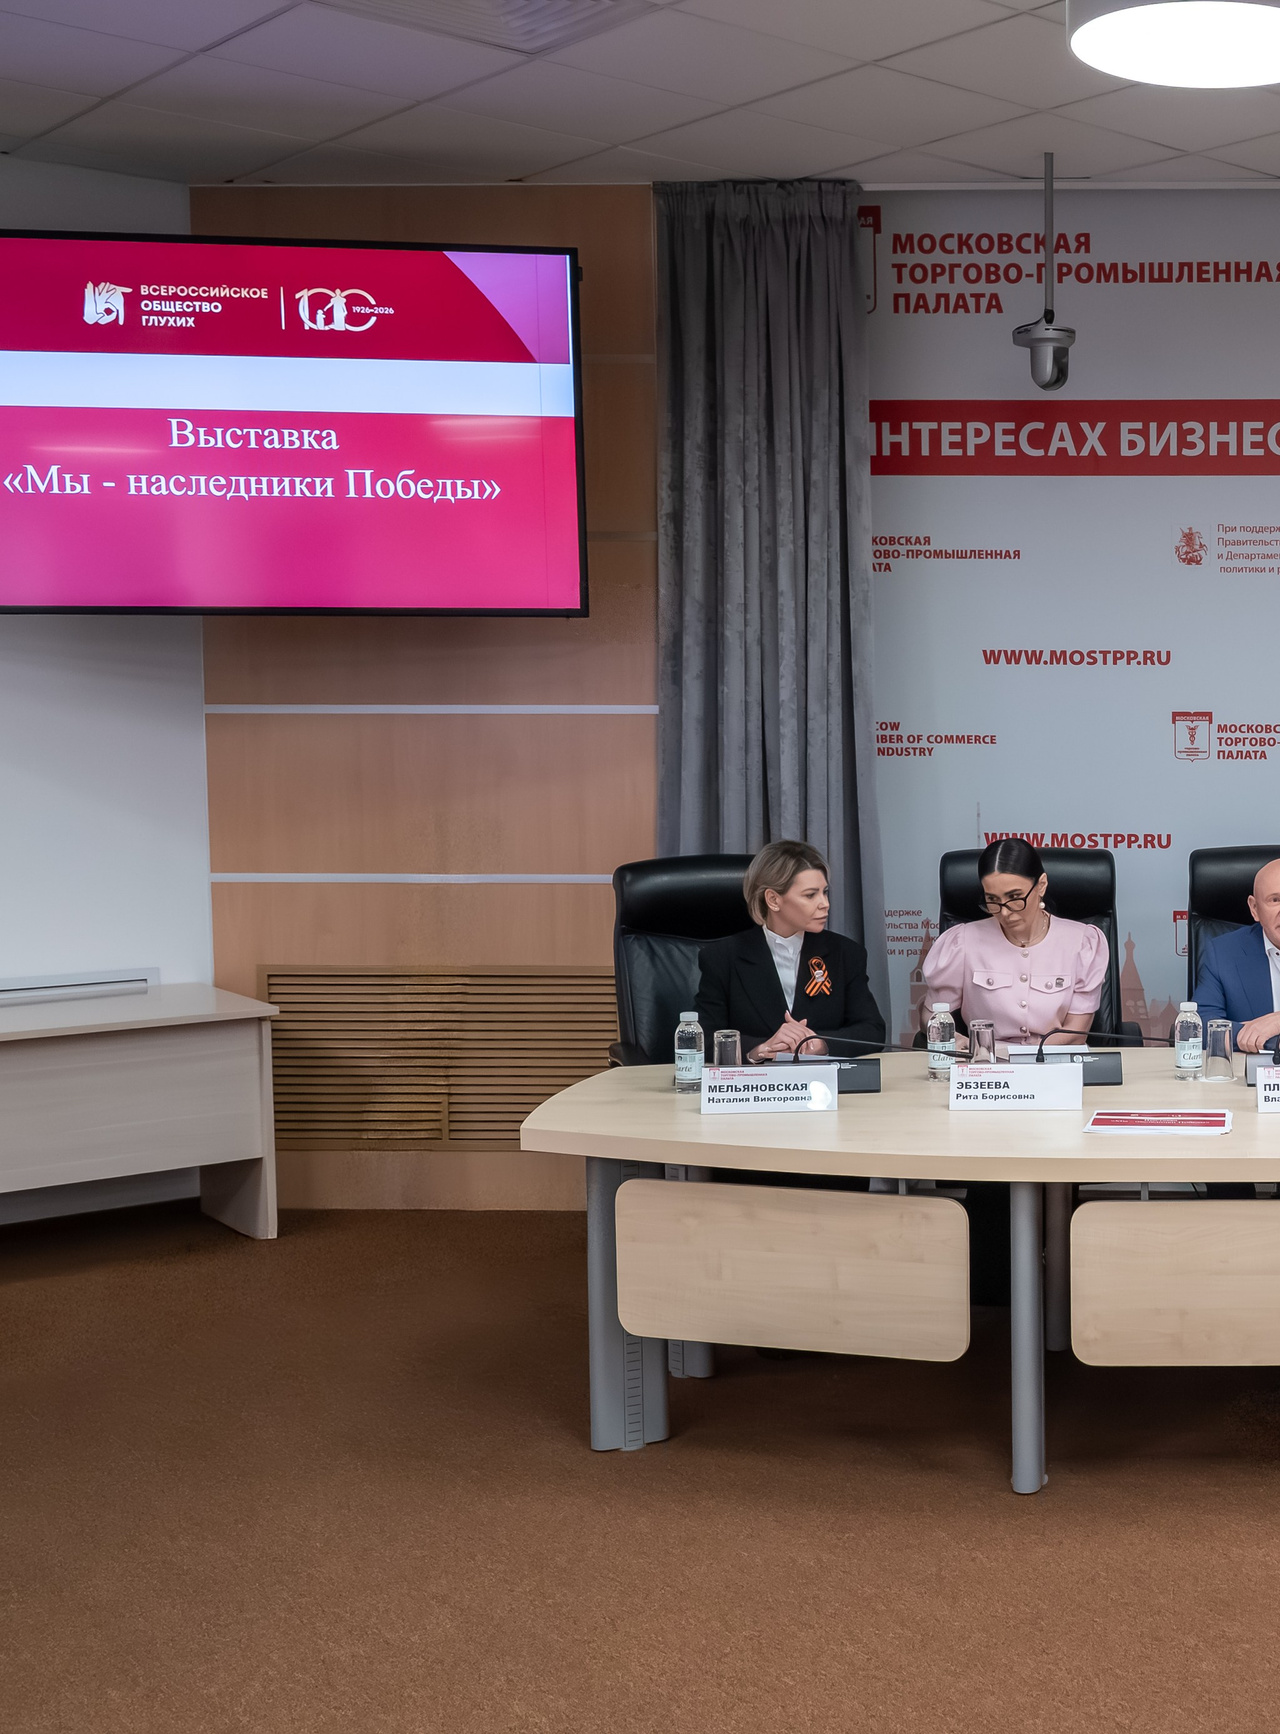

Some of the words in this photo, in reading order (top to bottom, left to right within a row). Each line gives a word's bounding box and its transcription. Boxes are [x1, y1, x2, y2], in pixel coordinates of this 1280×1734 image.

[892, 233, 1091, 254] МОСКОВСКАЯ
[140, 284, 269, 299] ВСЕРОССИЙСКОЕ
[140, 300, 223, 314] ОБЩЕСТВО
[893, 293, 1004, 314] ПАЛАТА
[141, 315, 196, 328] ГЛУХИХ
[167, 417, 339, 450] Выставка
[3, 464, 90, 495] «Мы
[127, 473, 335, 500] наследники
[345, 469, 501, 503] Победы»
[1217, 523, 1237, 534] При
[1217, 552, 1224, 560] и
[1219, 565, 1266, 574] политики
[1268, 565, 1275, 574] и
[982, 649, 1171, 666] WWW.MOSTPP.RU
[906, 734, 923, 744] OF
[926, 734, 997, 744] COMMERCE
[1217, 750, 1268, 760] ПАЛАТА
[885, 922, 919, 930] льства
[708, 1083, 808, 1093] МЕЛЬЯНОВСКАЯ
[956, 1081, 1010, 1090] ЭБЗЕЕВА
[708, 1096, 750, 1104] Наталия
[753, 1095, 812, 1103] Викторовна
[981, 1093, 1035, 1101] Борисовна
